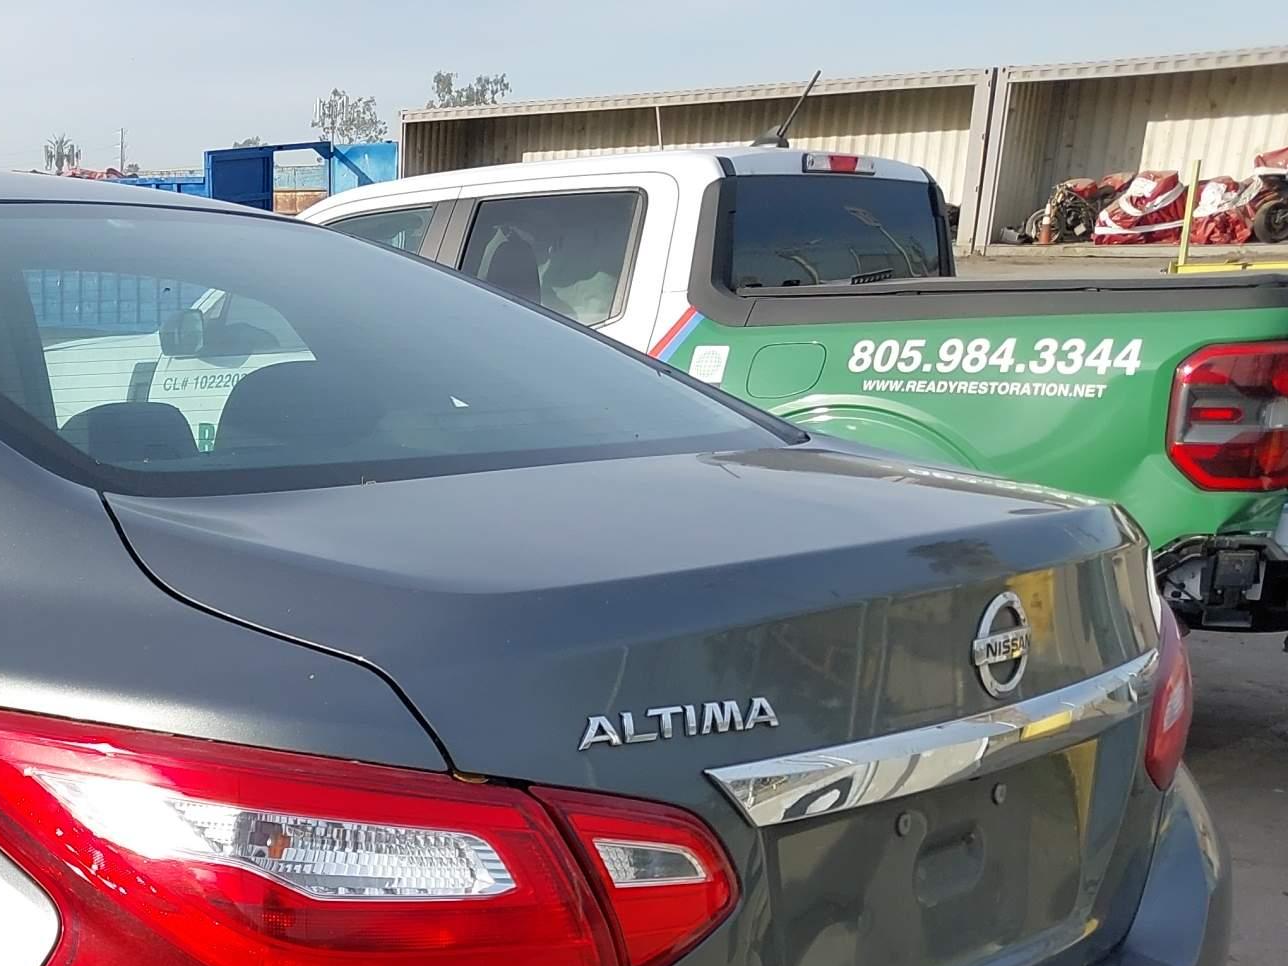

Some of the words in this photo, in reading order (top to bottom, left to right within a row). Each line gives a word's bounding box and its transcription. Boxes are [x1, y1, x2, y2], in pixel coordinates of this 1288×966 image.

[848, 338, 1142, 376] 805.984.3344
[163, 377, 189, 391] CL#
[862, 379, 1106, 398] WWW.READYRESTORATION.NET
[985, 632, 1031, 659] NISSAN
[577, 696, 780, 752] ALTIMA
